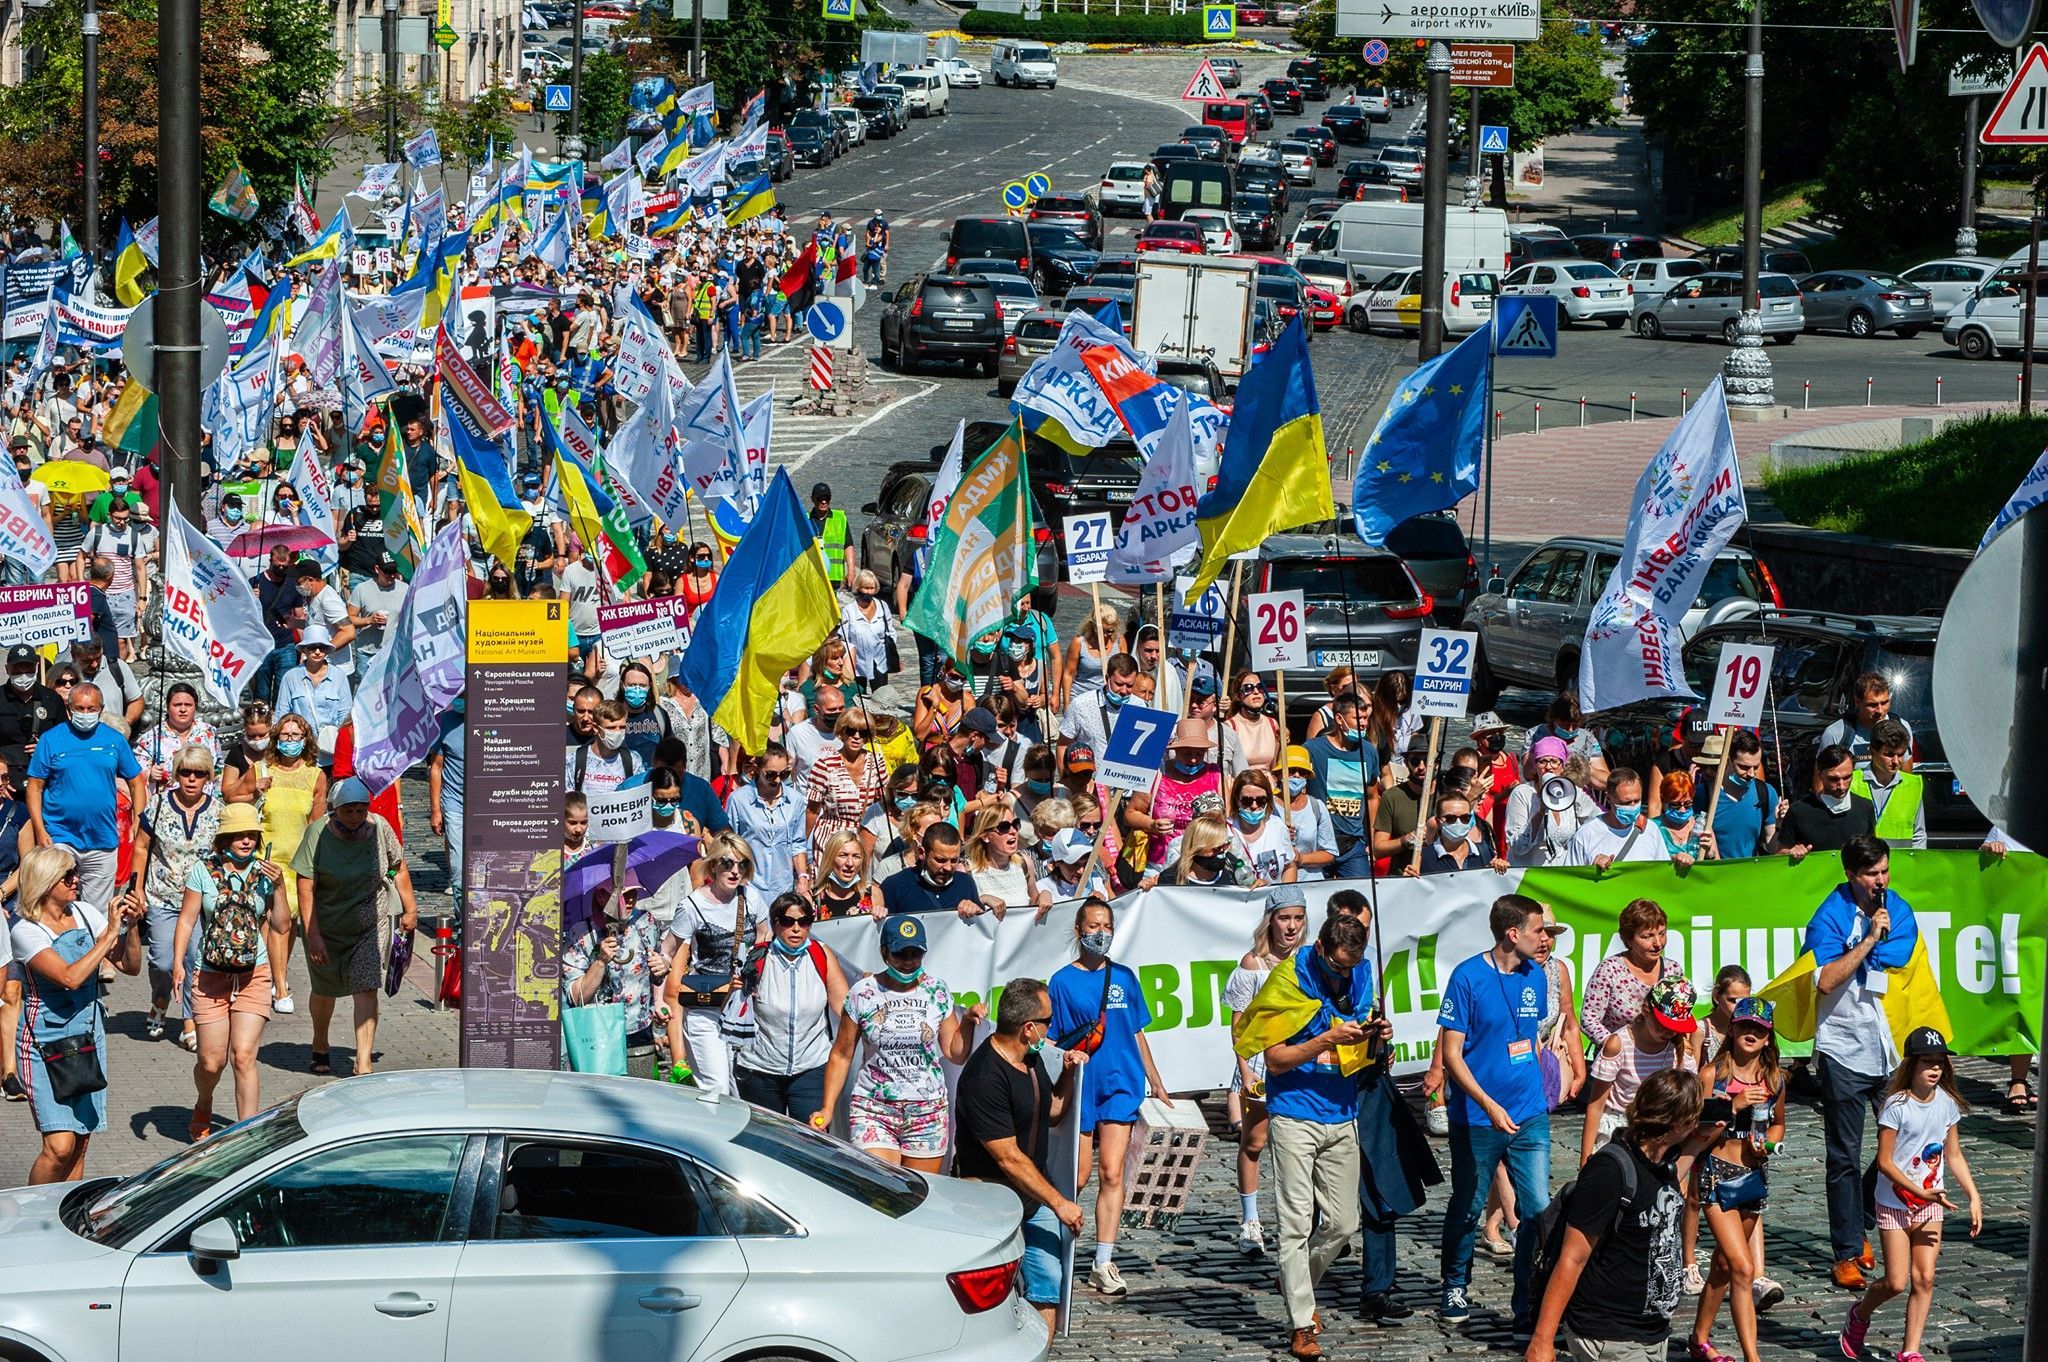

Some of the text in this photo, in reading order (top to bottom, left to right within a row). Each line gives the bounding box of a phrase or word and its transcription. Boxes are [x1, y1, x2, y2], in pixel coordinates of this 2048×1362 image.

[1411, 4, 1536, 19] аеропорт «КИЇВ»
[1411, 19, 1492, 29] airport «KYIV»
[1469, 50, 1492, 58] ГЕРОЇВ
[707, 205, 714, 216] 9
[390, 221, 397, 232] 9
[355, 253, 366, 266] 16
[378, 251, 389, 264] 15
[72, 301, 85, 314] The
[1370, 297, 1392, 308] uklon
[629, 331, 669, 360] МИ НА
[621, 352, 635, 365] БЕЗ
[1072, 518, 1107, 550] 27
[1631, 467, 1732, 592] ІНВЕСТОРИ
[1075, 551, 1108, 563] ЗБАРАЖ
[13, 588, 53, 602] ЕВРИКА
[32, 609, 72, 621] ПОДІЛАСЬ
[600, 608, 617, 621] ЖК
[618, 603, 654, 618] ЕВРИКА
[1256, 600, 1298, 645] 26
[0, 622, 87, 641] ВАША СОВІСТЬ ?
[475, 629, 536, 638] Національний
[606, 620, 673, 643] ДОСИТЬ БРЕХАТИ
[475, 638, 544, 647] художній музей
[634, 636, 676, 652] БУДУВАТИ
[1268, 656, 1291, 664] ЕВРИКА
[1427, 637, 1469, 675] 32
[484, 671, 531, 679] Європейська
[1725, 654, 1762, 700] 19
[1423, 679, 1462, 692] БАТУРИН
[1724, 711, 1745, 719] ЕВРИКА
[483, 737, 511, 745] Майдан
[1129, 720, 1157, 756] 7
[530, 780, 548, 788] Арка
[492, 789, 520, 797] дружби
[591, 795, 650, 815] СИНЕВИР
[492, 819, 522, 827] Паркова
[601, 810, 643, 827] дом 23
